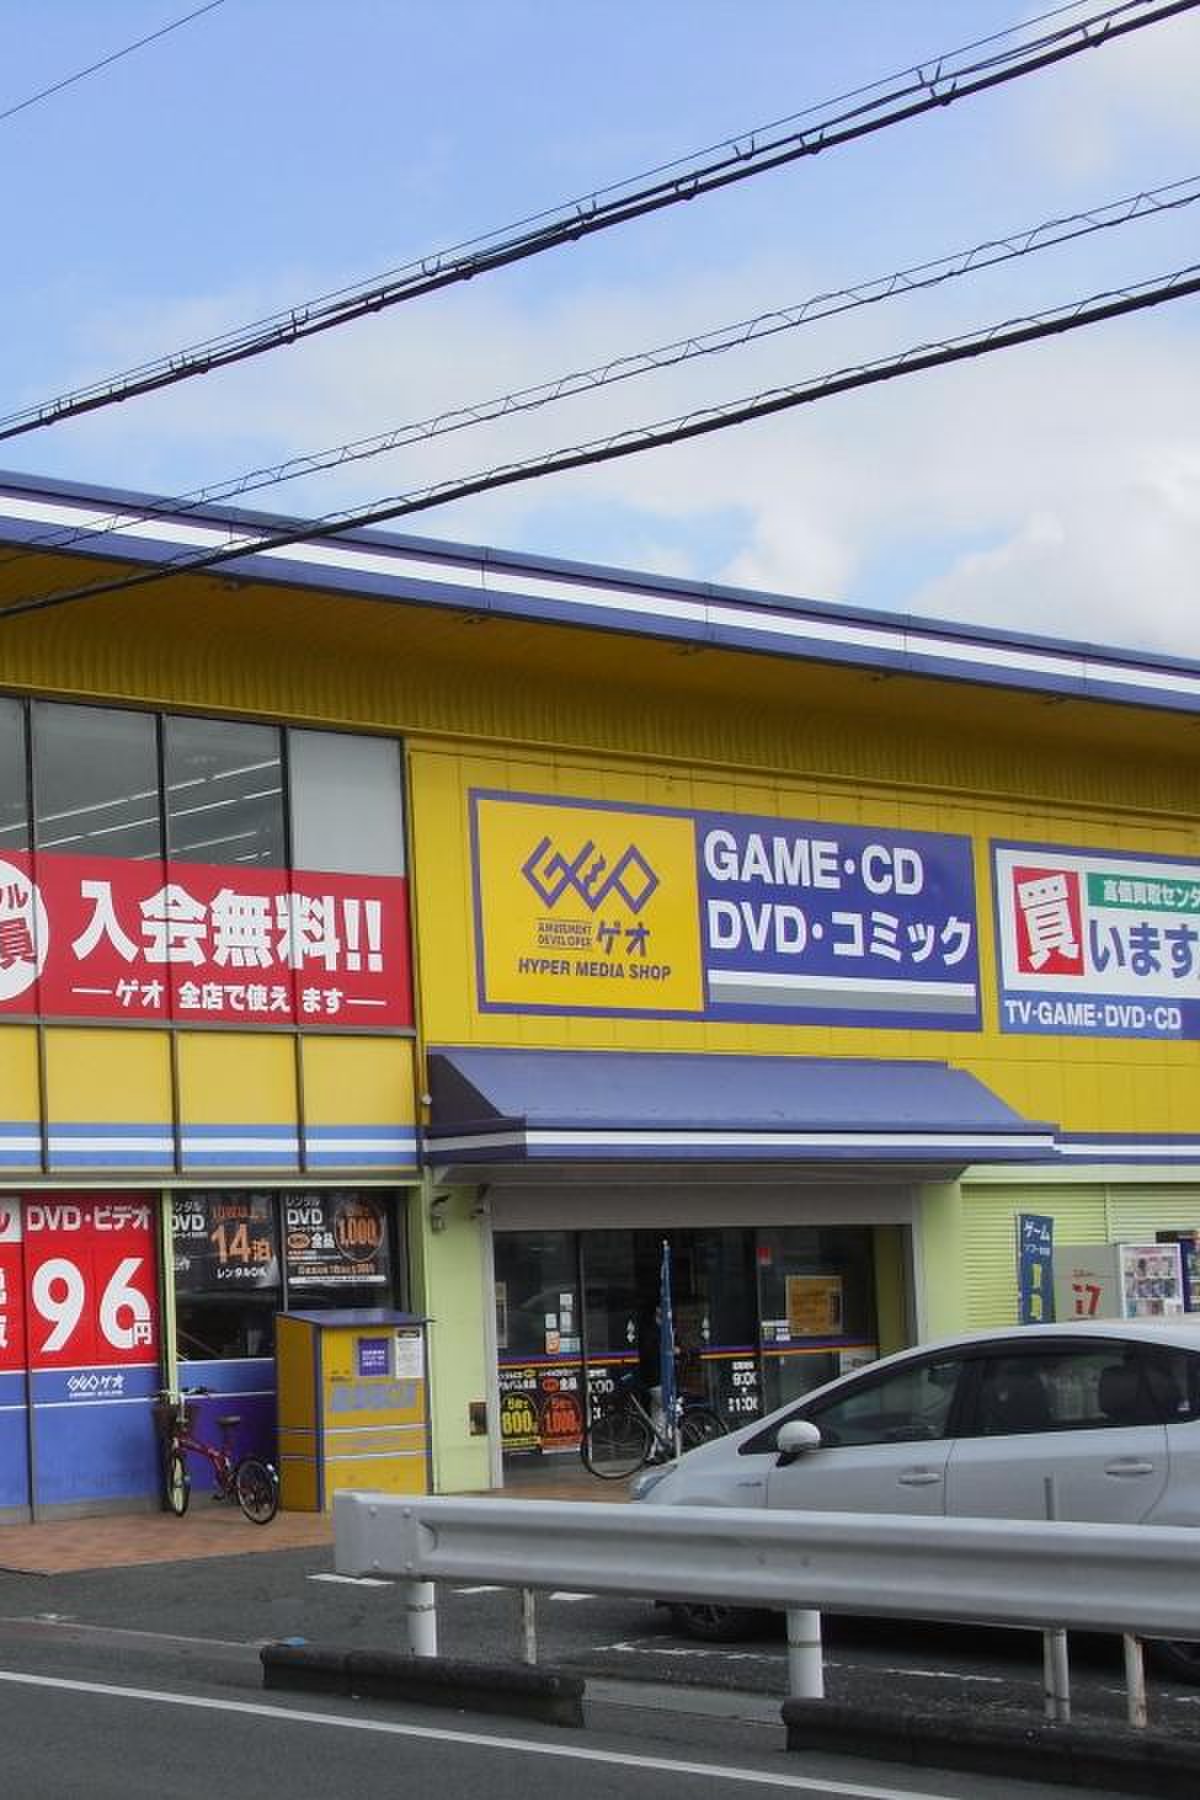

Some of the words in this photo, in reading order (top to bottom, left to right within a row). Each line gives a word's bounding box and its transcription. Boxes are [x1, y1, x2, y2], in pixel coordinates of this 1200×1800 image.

[596, 920, 650, 957] ゲオ
[518, 957, 571, 975] HYPER
[575, 961, 624, 979] MEDIA
[628, 964, 671, 981] SHOP
[287, 1208, 323, 1225] DVD
